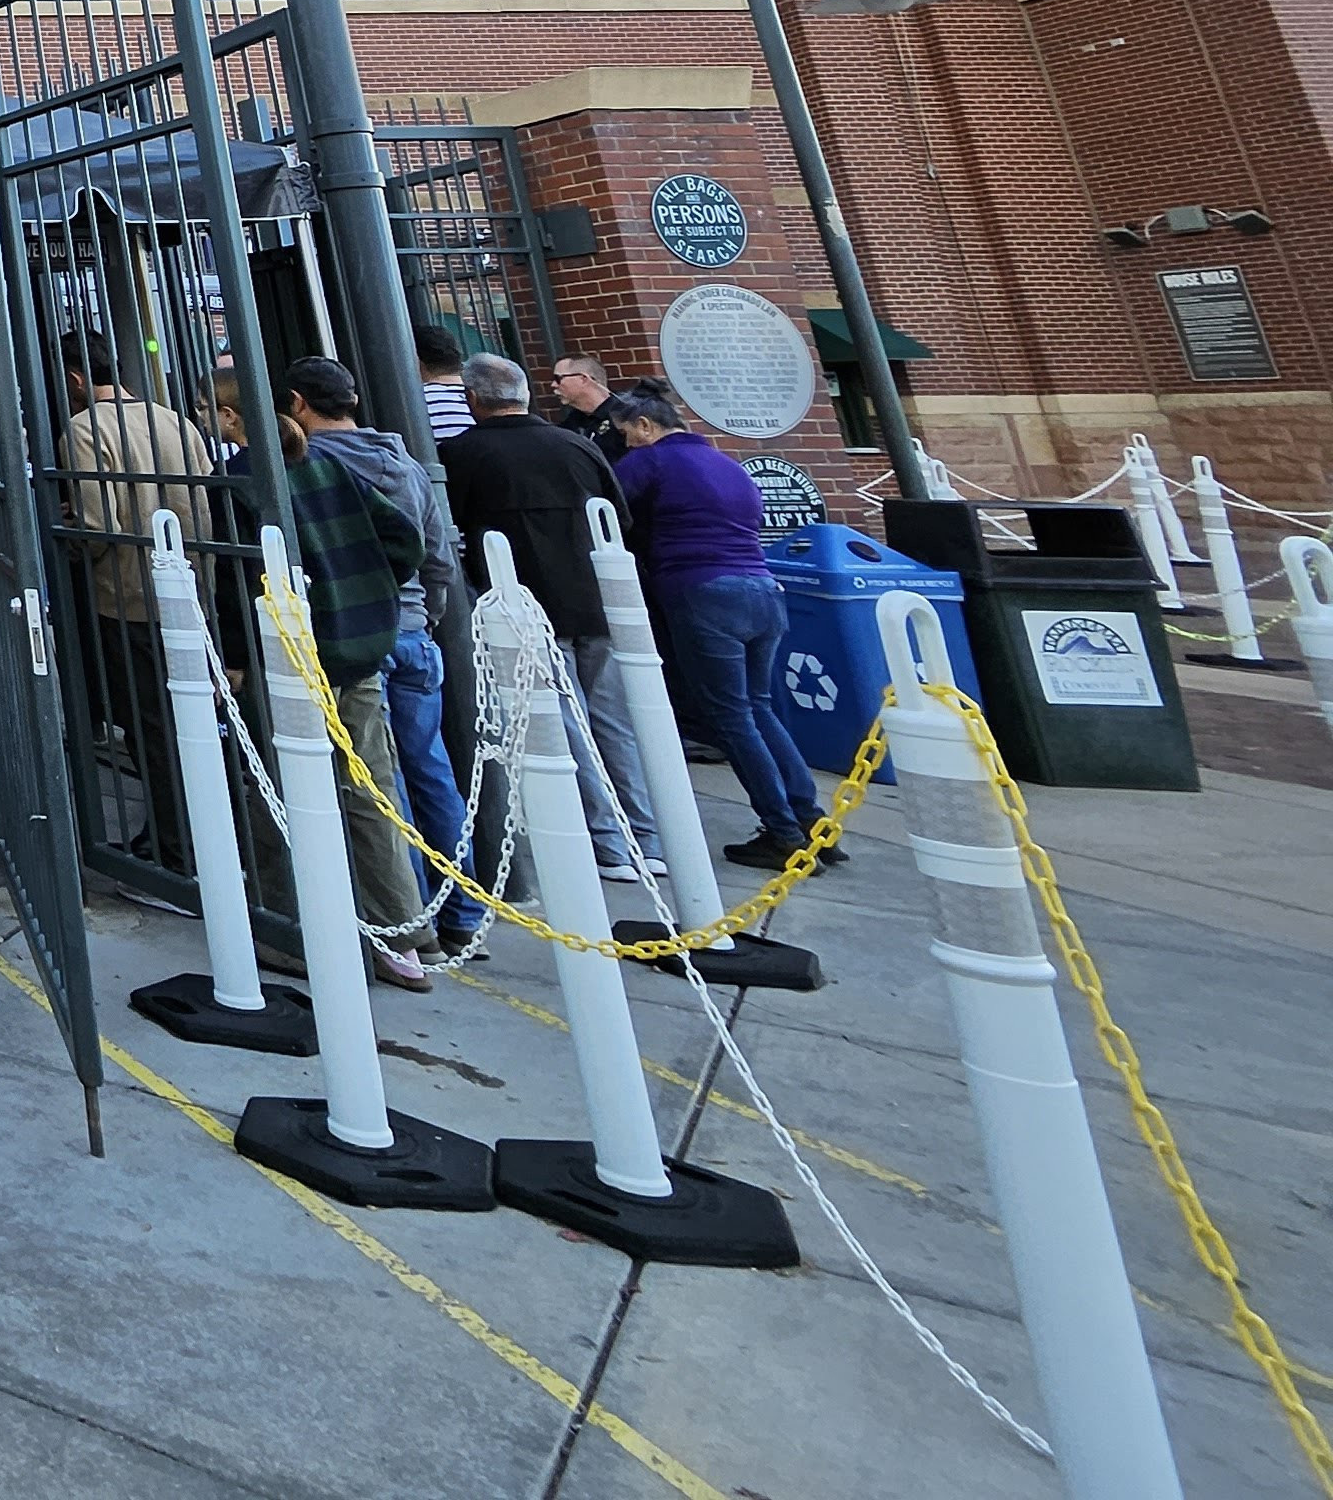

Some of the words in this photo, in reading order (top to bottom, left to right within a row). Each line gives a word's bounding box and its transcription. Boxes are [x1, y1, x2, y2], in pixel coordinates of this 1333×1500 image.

[659, 180, 685, 203] ALL
[685, 177, 727, 202] BAGS
[656, 204, 740, 225] PERSONS
[664, 226, 684, 237] ARE
[685, 225, 728, 236] SUBJECT
[730, 225, 744, 235] TO
[77, 242, 96, 258] HA
[673, 238, 739, 264] SEARCH
[707, 302, 744, 311] SPECTATOR
[721, 288, 762, 308] COLORADO
[760, 303, 778, 318] LAW
[724, 418, 764, 429] BASEBALL
[764, 459, 823, 506] REGULATIONS
